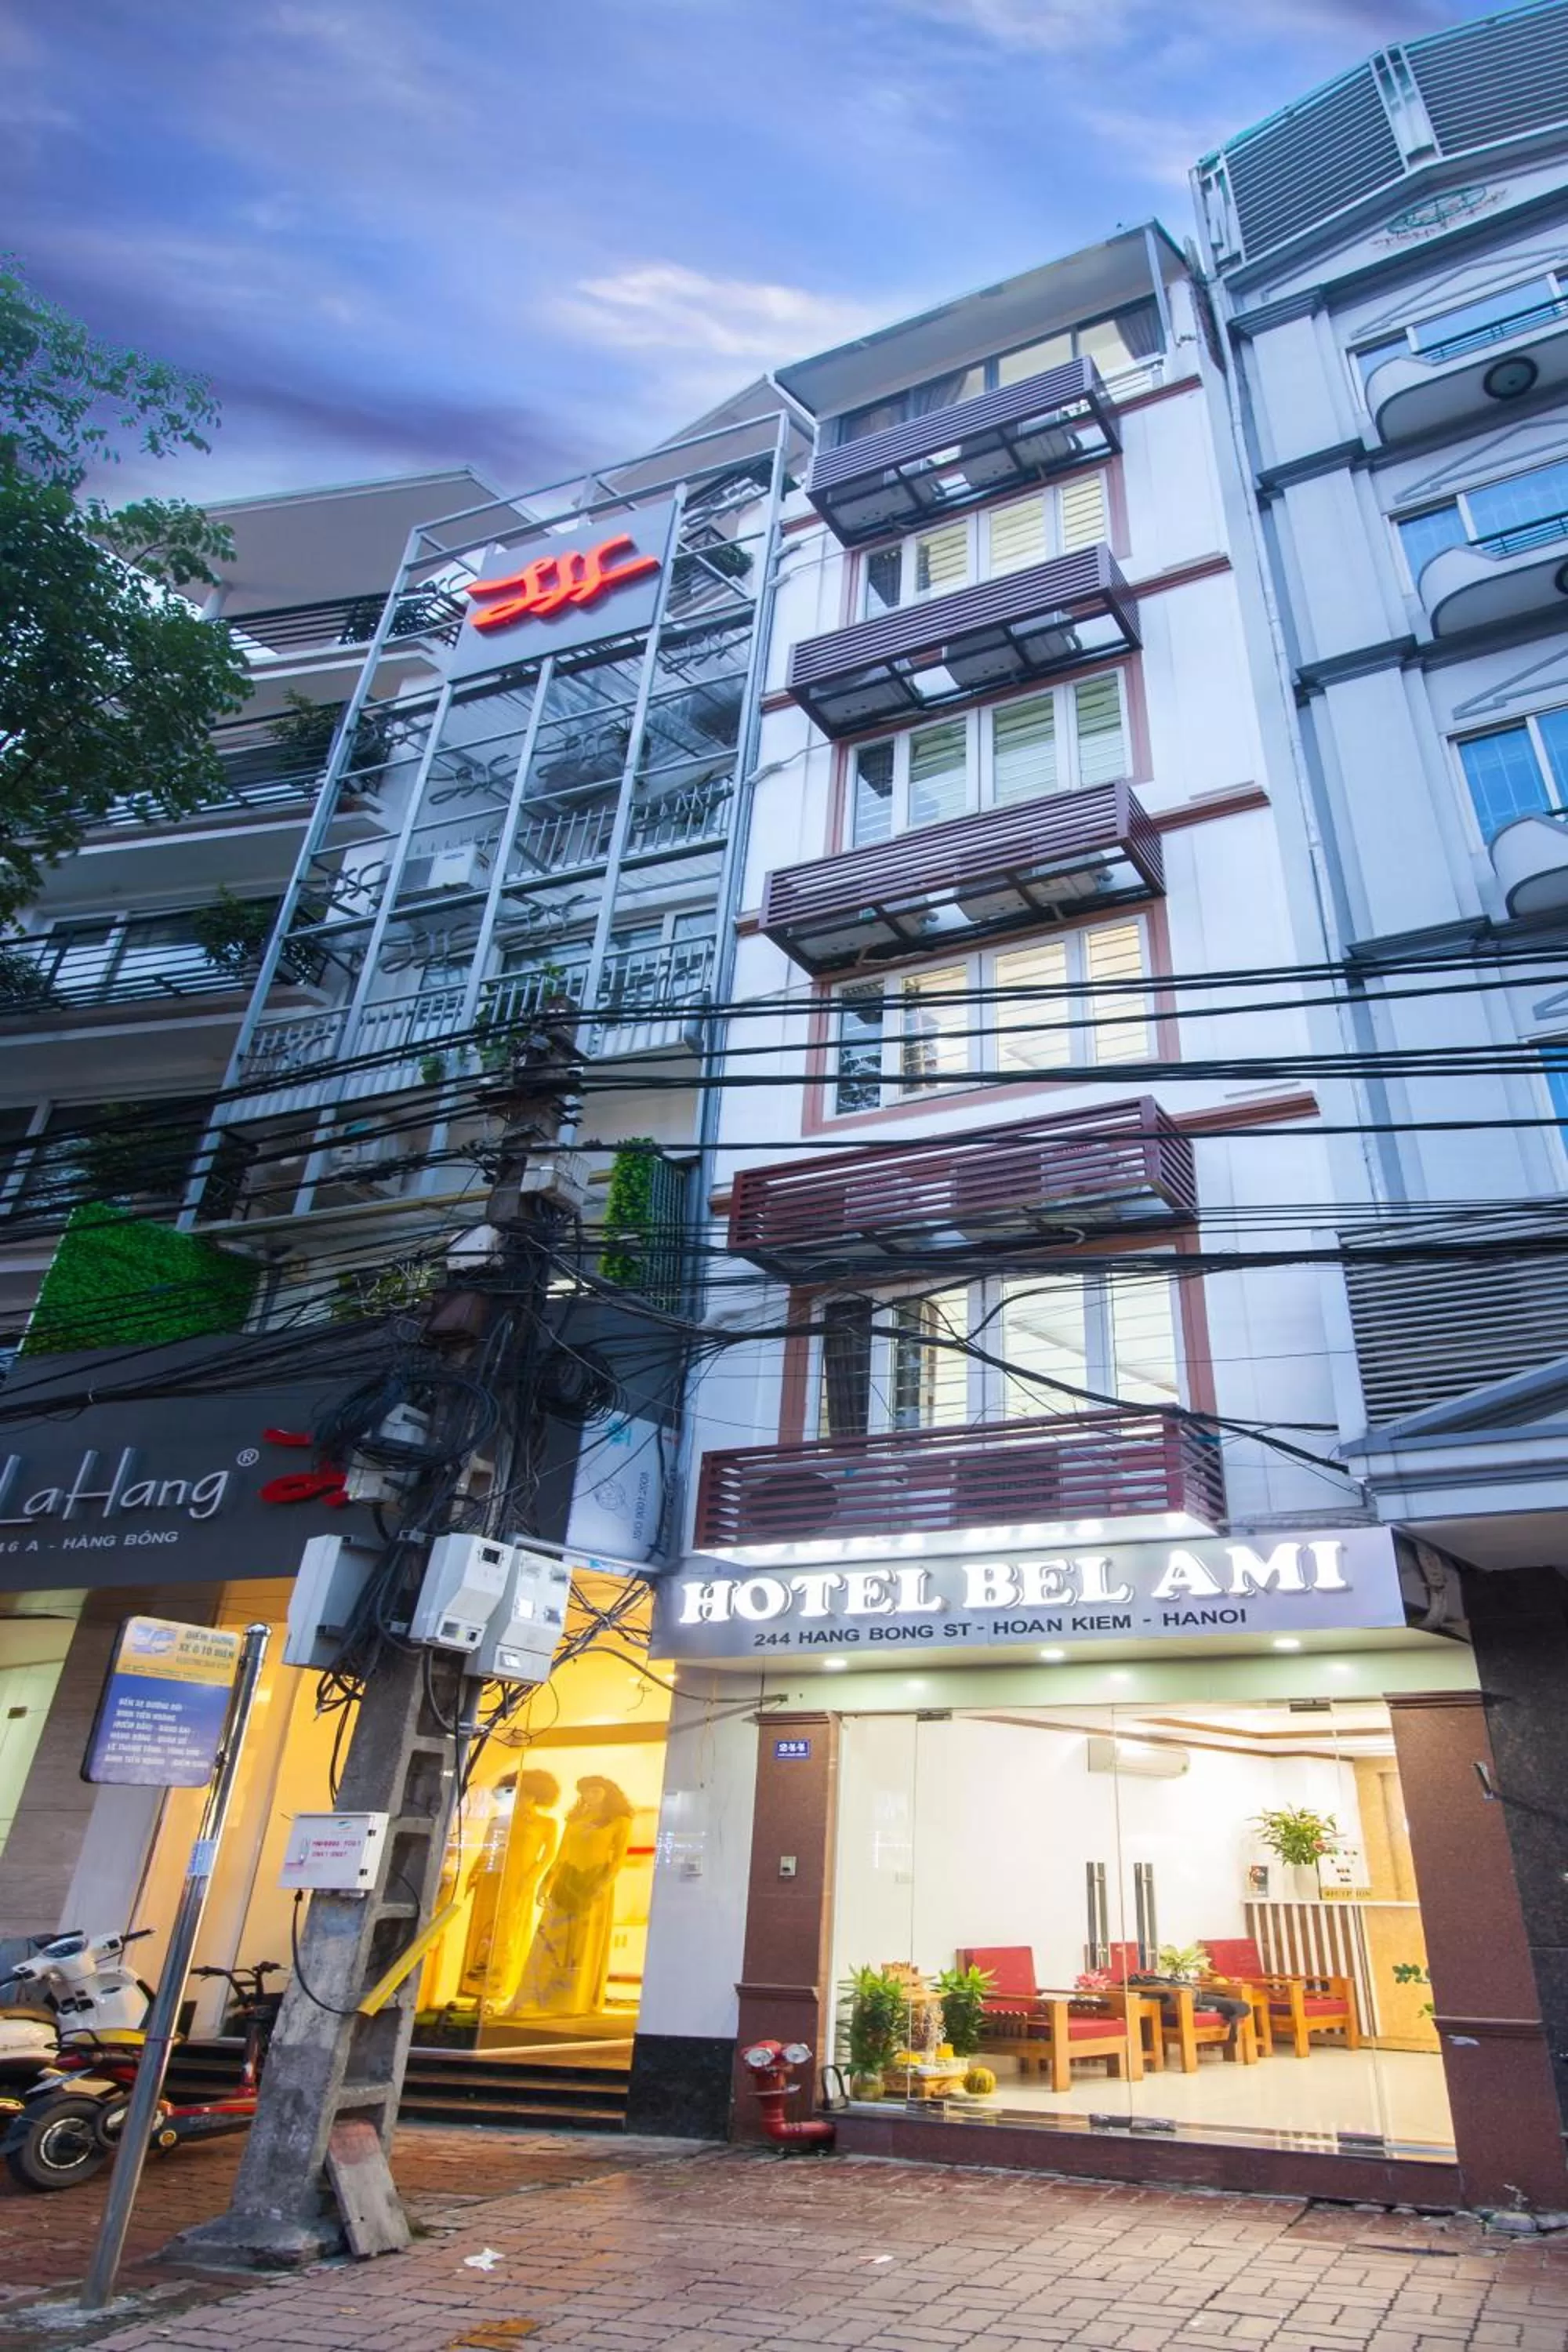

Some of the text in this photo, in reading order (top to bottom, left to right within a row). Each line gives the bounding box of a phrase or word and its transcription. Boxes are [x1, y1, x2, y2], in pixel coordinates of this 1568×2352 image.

[25, 1539, 38, 1552] A
[679, 1541, 1352, 1624] HOTEL BEL AMI
[753, 1632, 791, 1646] 244
[798, 1628, 860, 1644] HANG
[869, 1625, 934, 1641] BONG
[943, 1622, 971, 1637] ST
[993, 1618, 1063, 1635] HOAN
[1072, 1614, 1131, 1632] KIEM
[1163, 1609, 1247, 1626] HANOI
